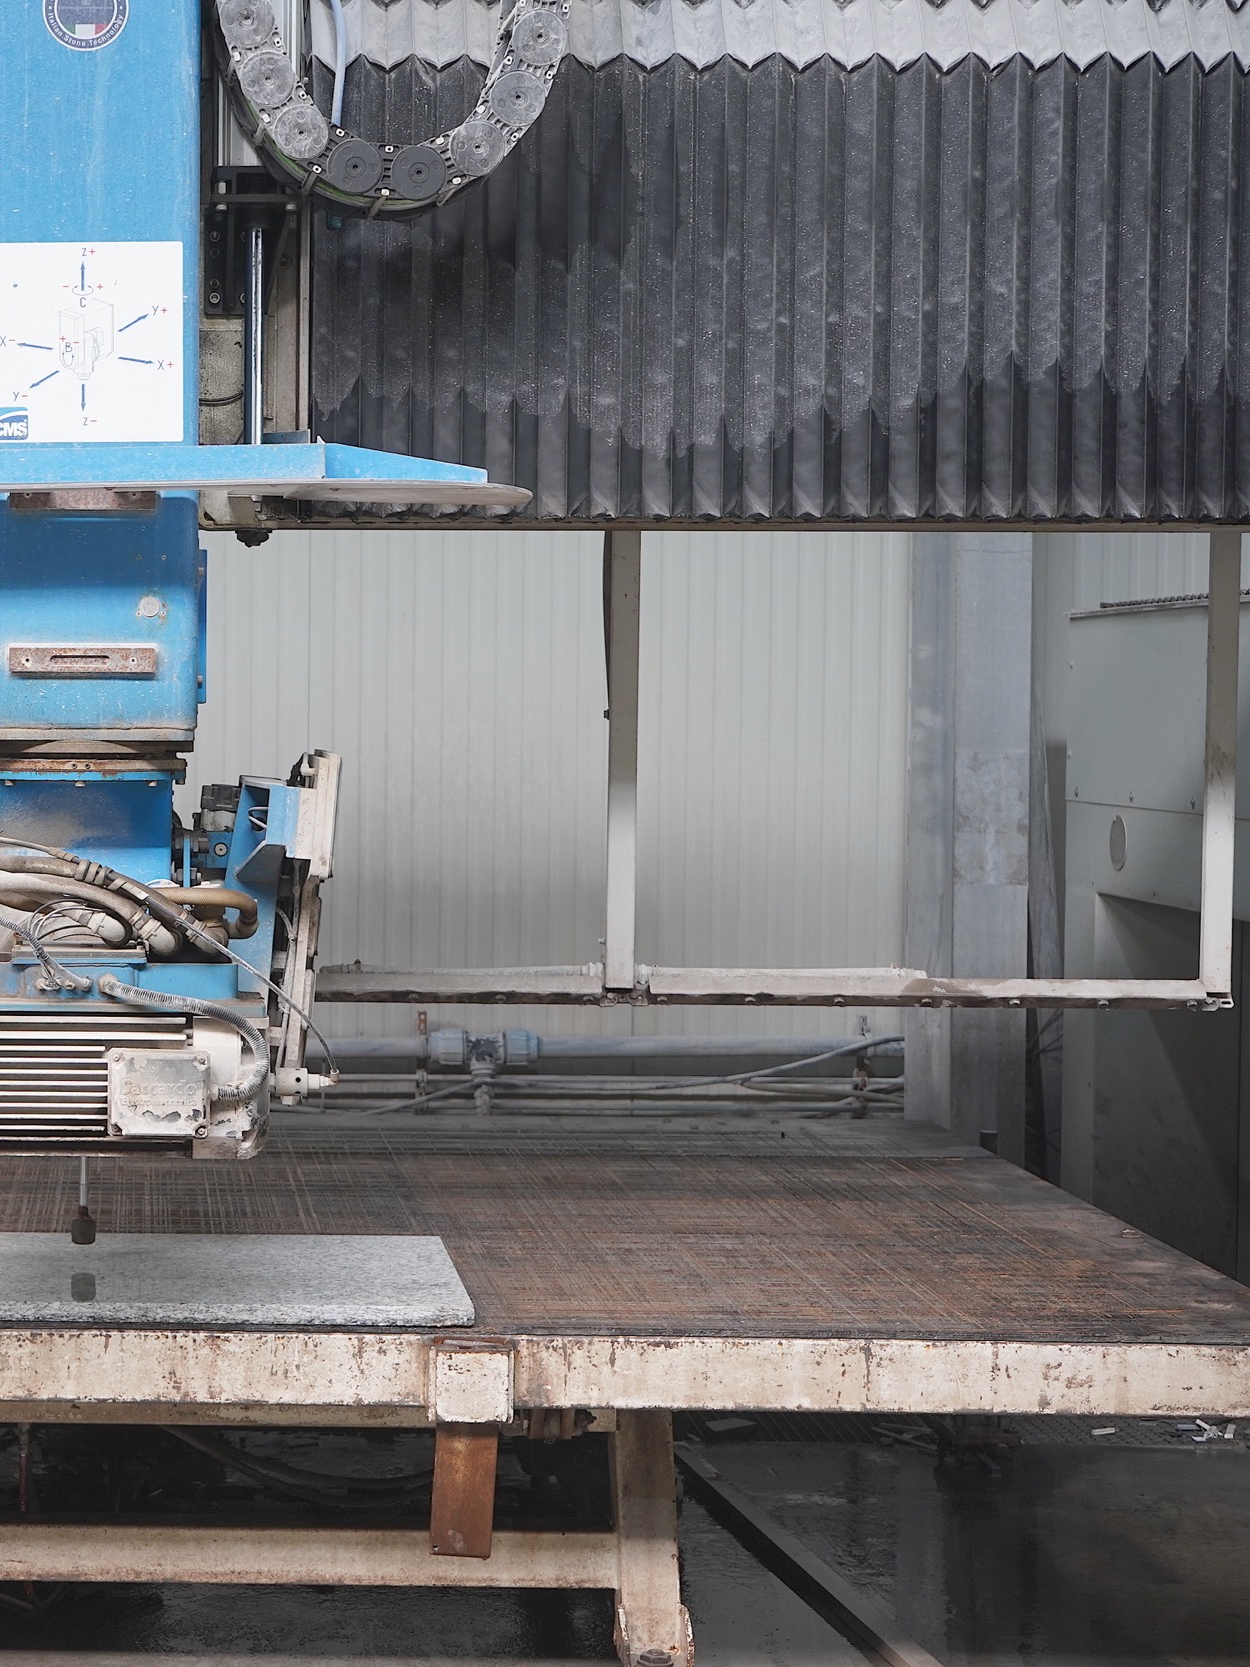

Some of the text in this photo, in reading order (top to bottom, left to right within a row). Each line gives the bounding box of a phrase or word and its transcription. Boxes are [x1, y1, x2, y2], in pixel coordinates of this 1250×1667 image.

[48, 12, 124, 46] Italian Stone Technology
[80, 297, 87, 307] C
[65, 342, 72, 352] B
